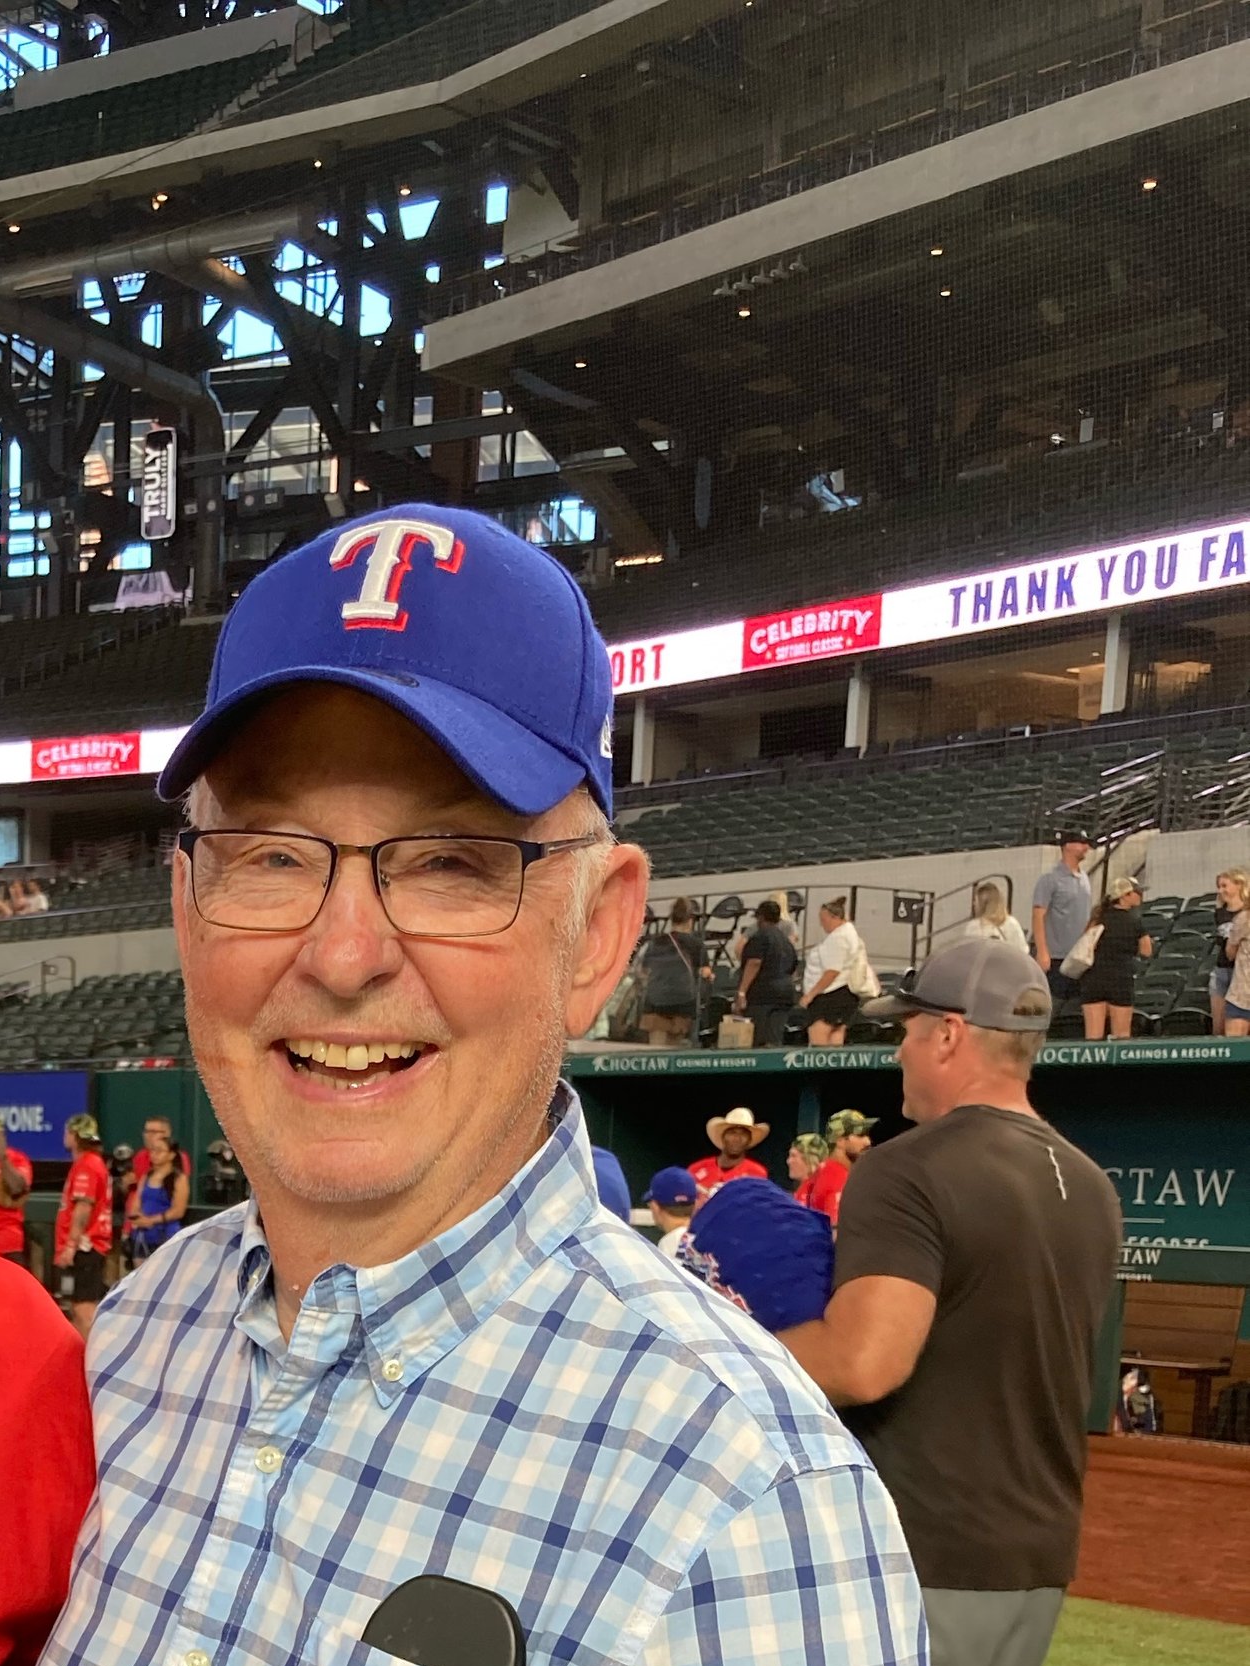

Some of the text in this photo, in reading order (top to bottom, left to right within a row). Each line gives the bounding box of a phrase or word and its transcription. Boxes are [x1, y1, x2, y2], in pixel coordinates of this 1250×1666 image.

[144, 447, 161, 523] TRULY
[330, 520, 466, 631] T
[949, 562, 1078, 627] THANK
[1098, 542, 1179, 600] YOU
[750, 609, 873, 654] CELEBRITY
[36, 741, 134, 769] CELEBRITY
[595, 1055, 669, 1072] CHOCTAW
[787, 1050, 873, 1069] CHOCTAW
[1120, 1049, 1168, 1060] CASINOS
[1181, 1047, 1231, 1059] RESORTS
